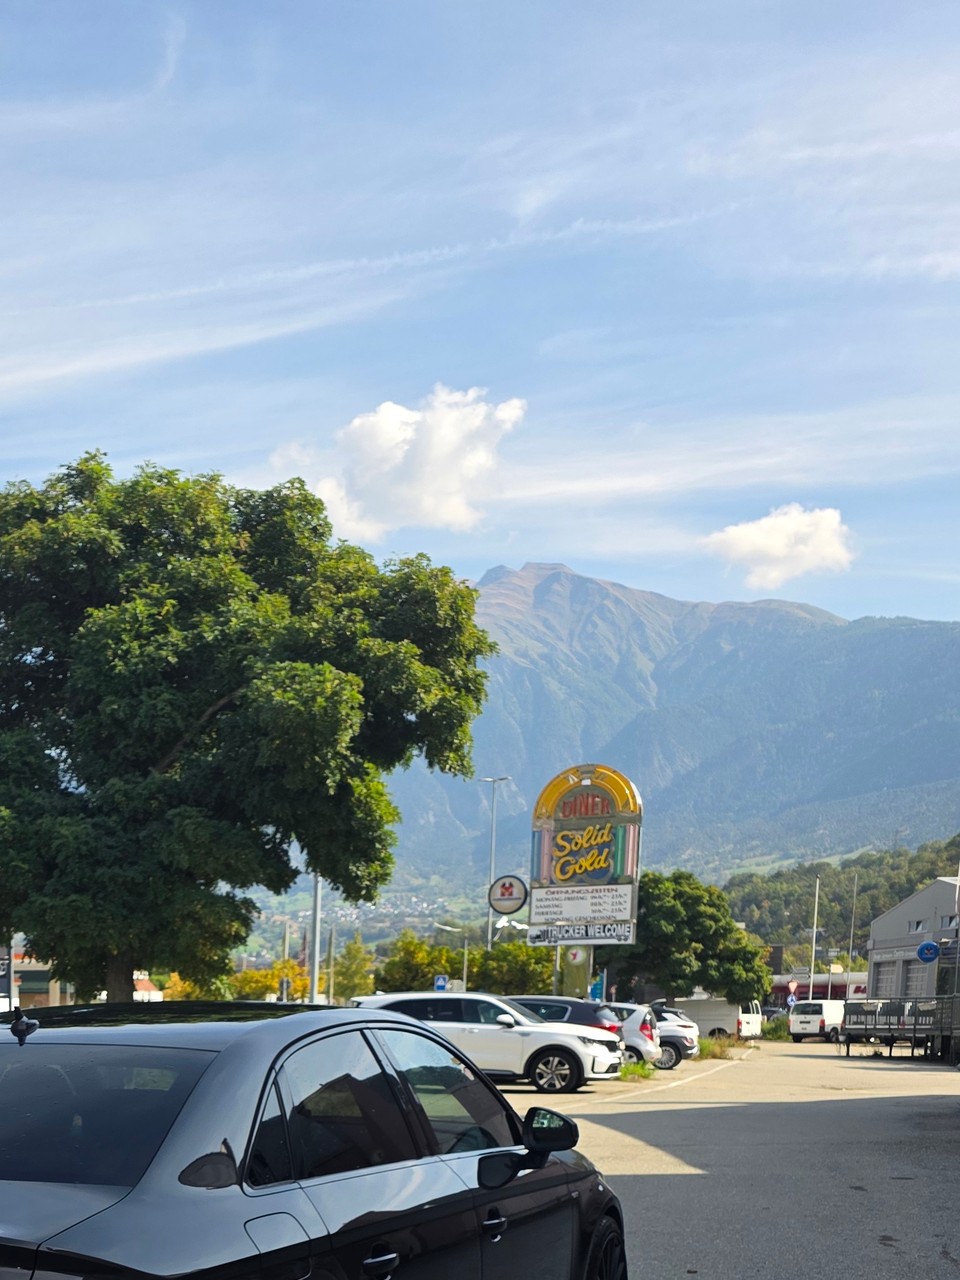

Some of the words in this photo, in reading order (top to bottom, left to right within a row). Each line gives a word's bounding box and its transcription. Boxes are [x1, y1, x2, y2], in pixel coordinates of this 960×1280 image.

[561, 793, 611, 818] DINER
[553, 823, 612, 857] Solid
[555, 848, 609, 880] Gold
[548, 925, 586, 938] TRUCKER
[587, 924, 631, 937] WELCOME
